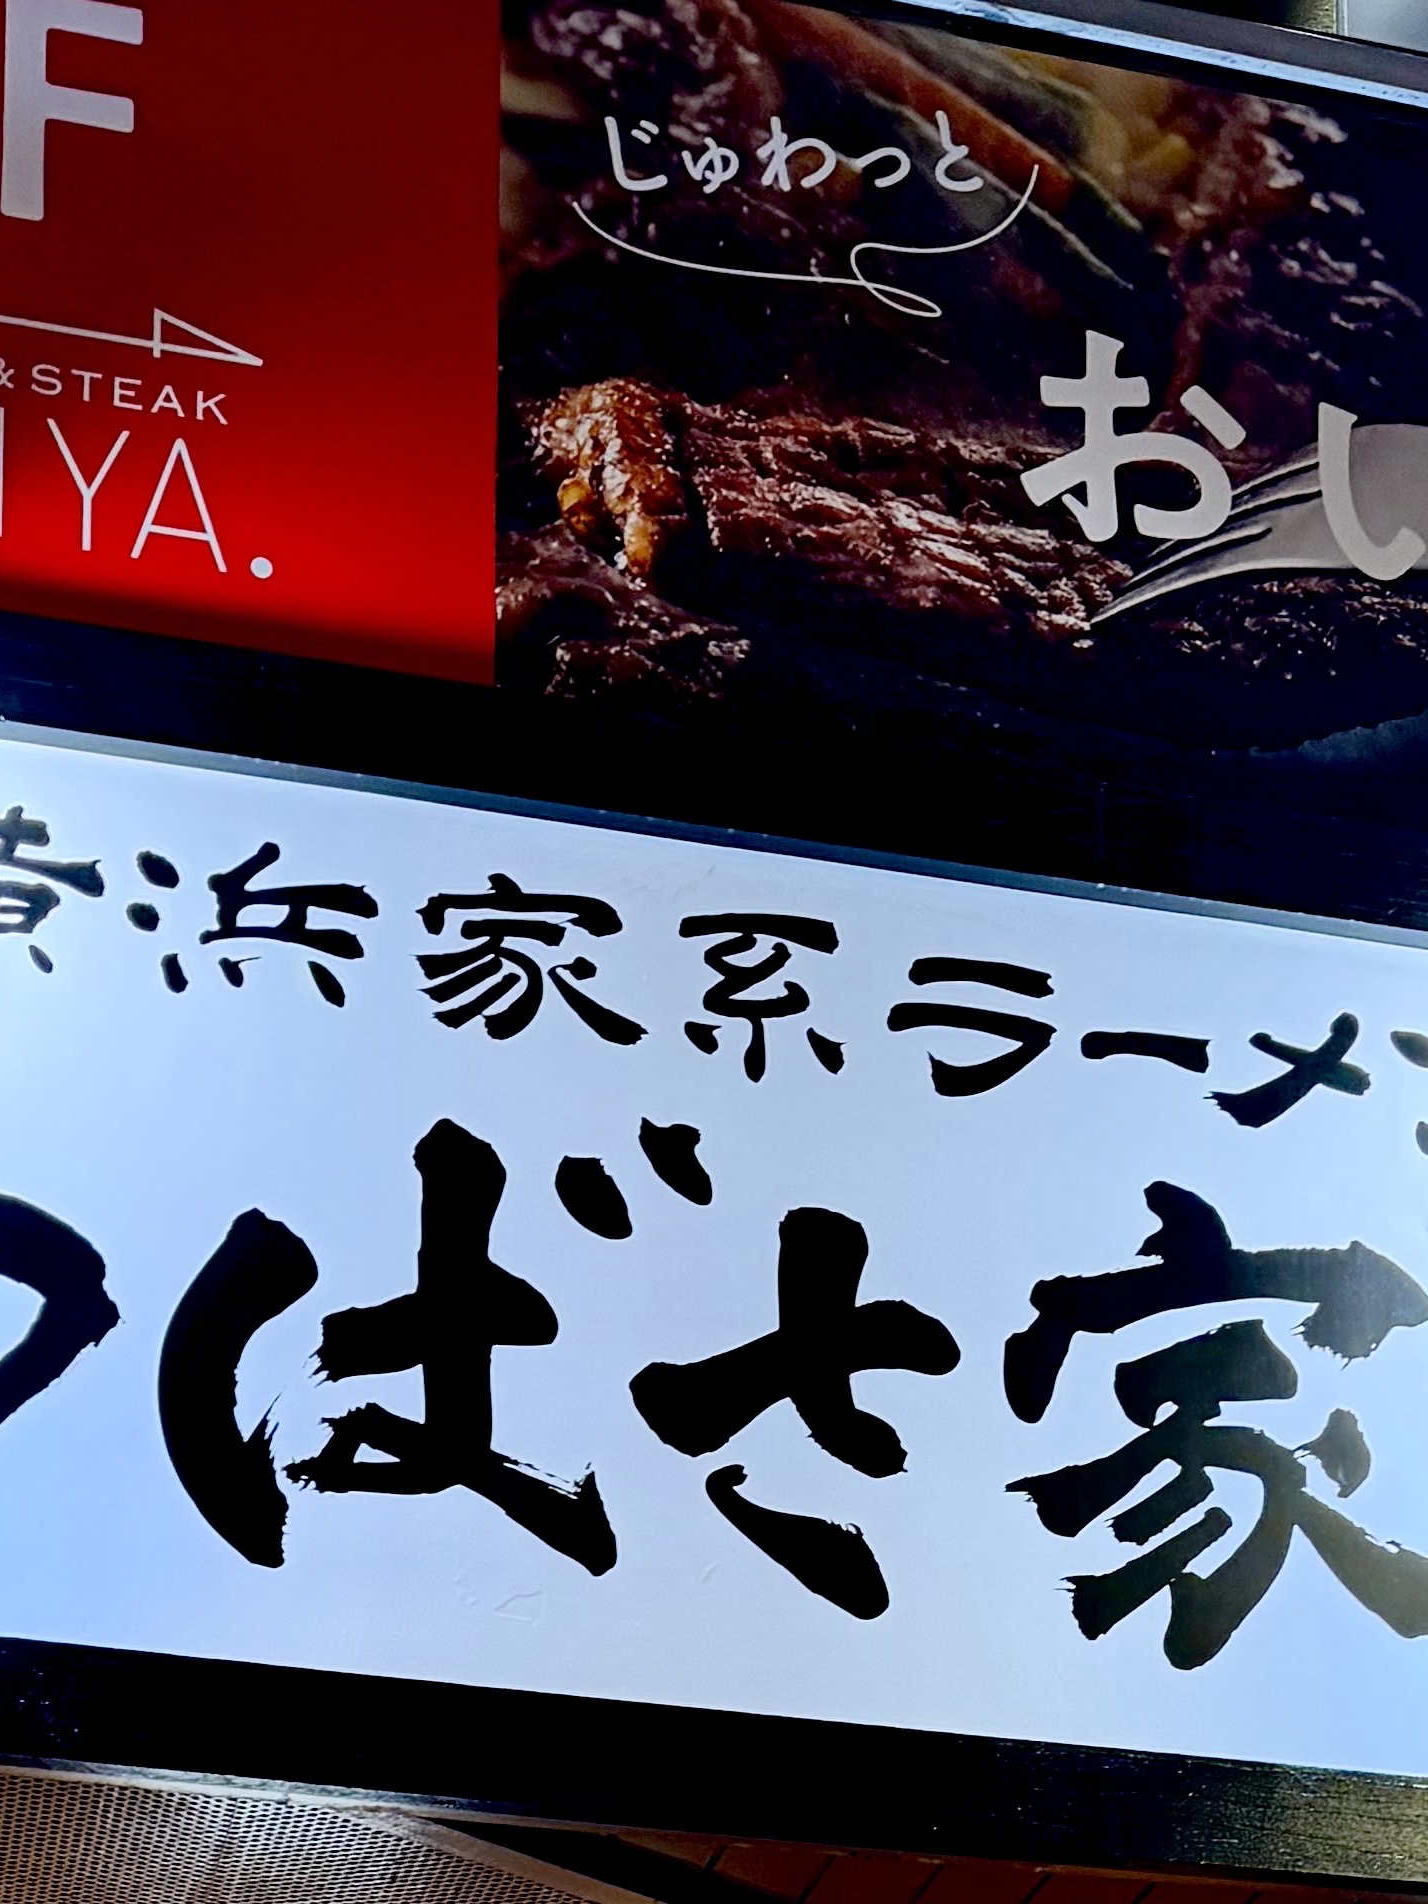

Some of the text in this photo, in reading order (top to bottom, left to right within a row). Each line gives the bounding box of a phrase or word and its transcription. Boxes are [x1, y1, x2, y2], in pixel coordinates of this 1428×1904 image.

[606, 110, 985, 193] じゅわっと
